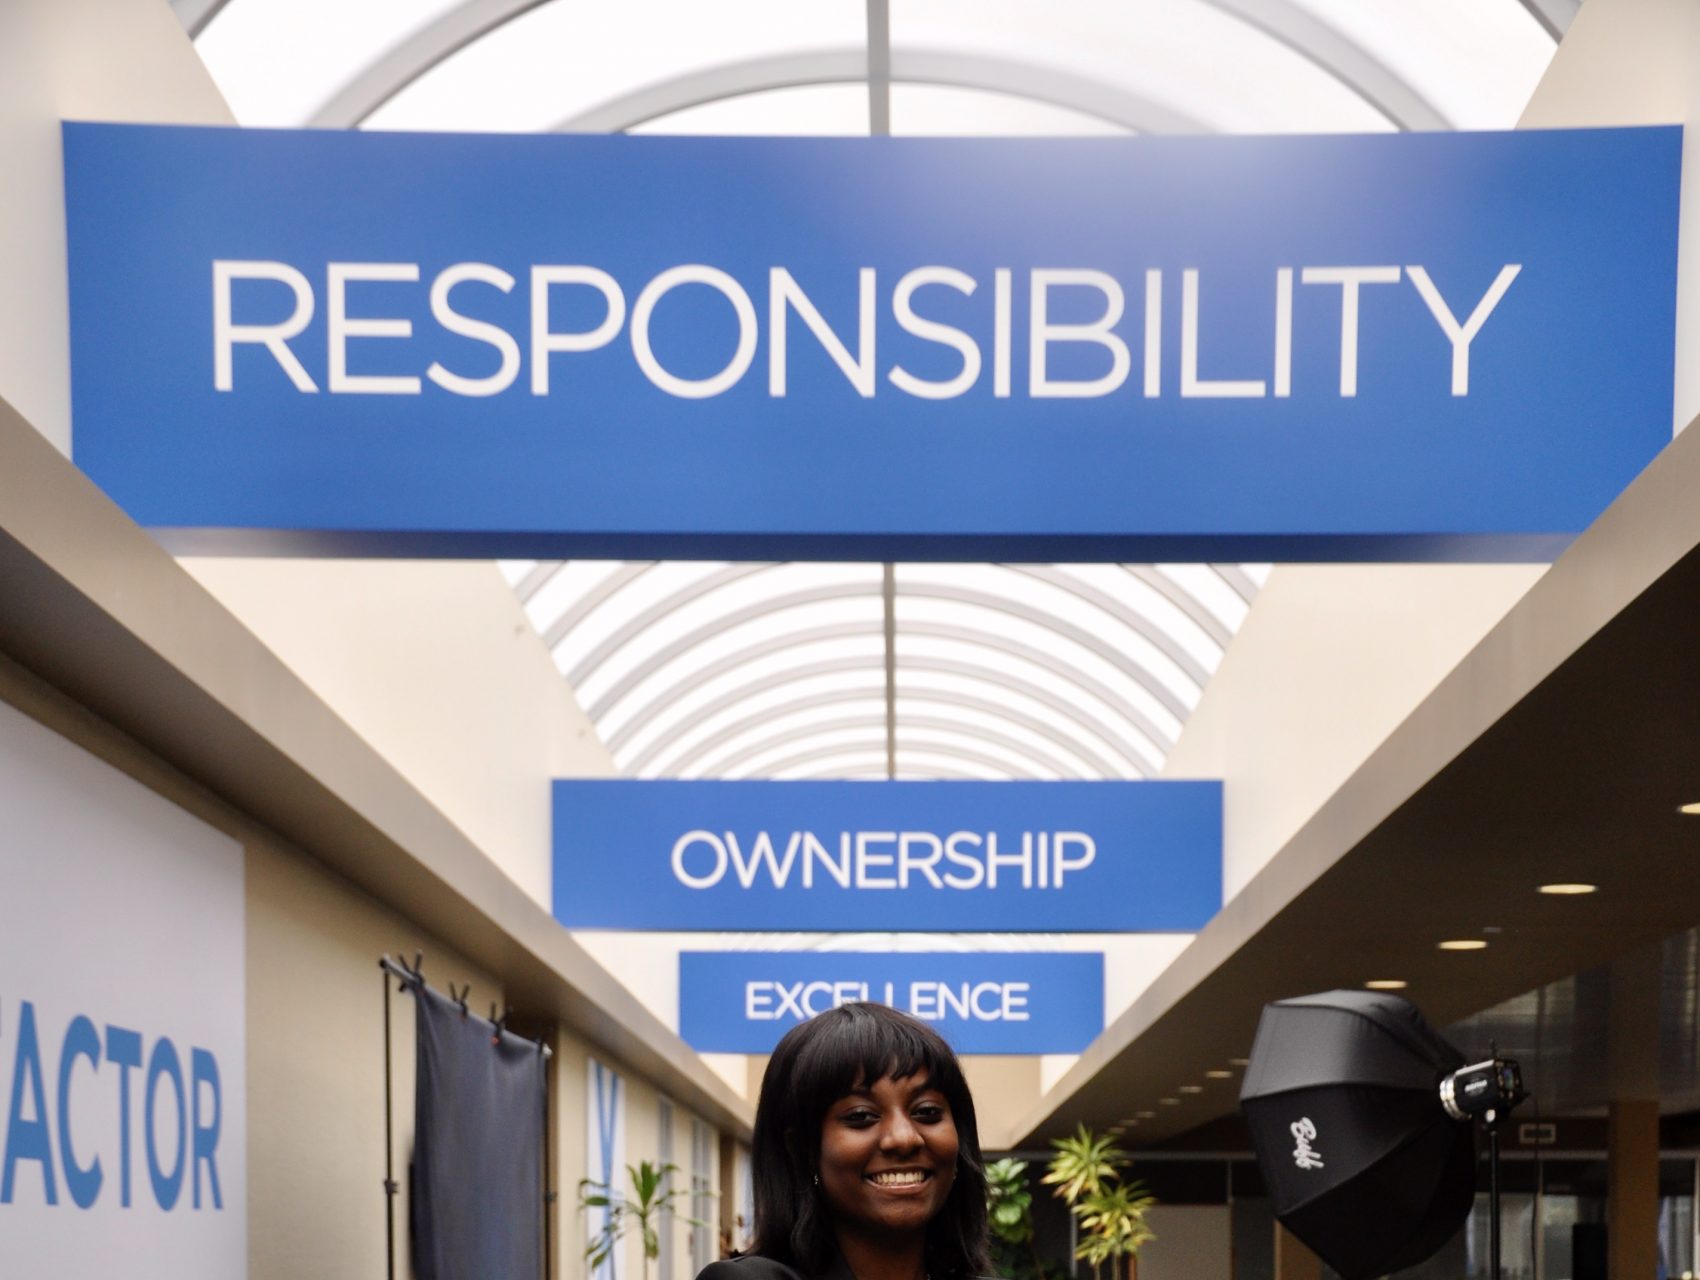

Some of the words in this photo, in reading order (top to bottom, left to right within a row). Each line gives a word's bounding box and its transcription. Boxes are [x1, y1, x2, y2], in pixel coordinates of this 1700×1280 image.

[211, 259, 1523, 399] RESPONSIBILITY
[671, 830, 1097, 889] OWNERSHIP
[0, 997, 223, 1212] ACTOR
